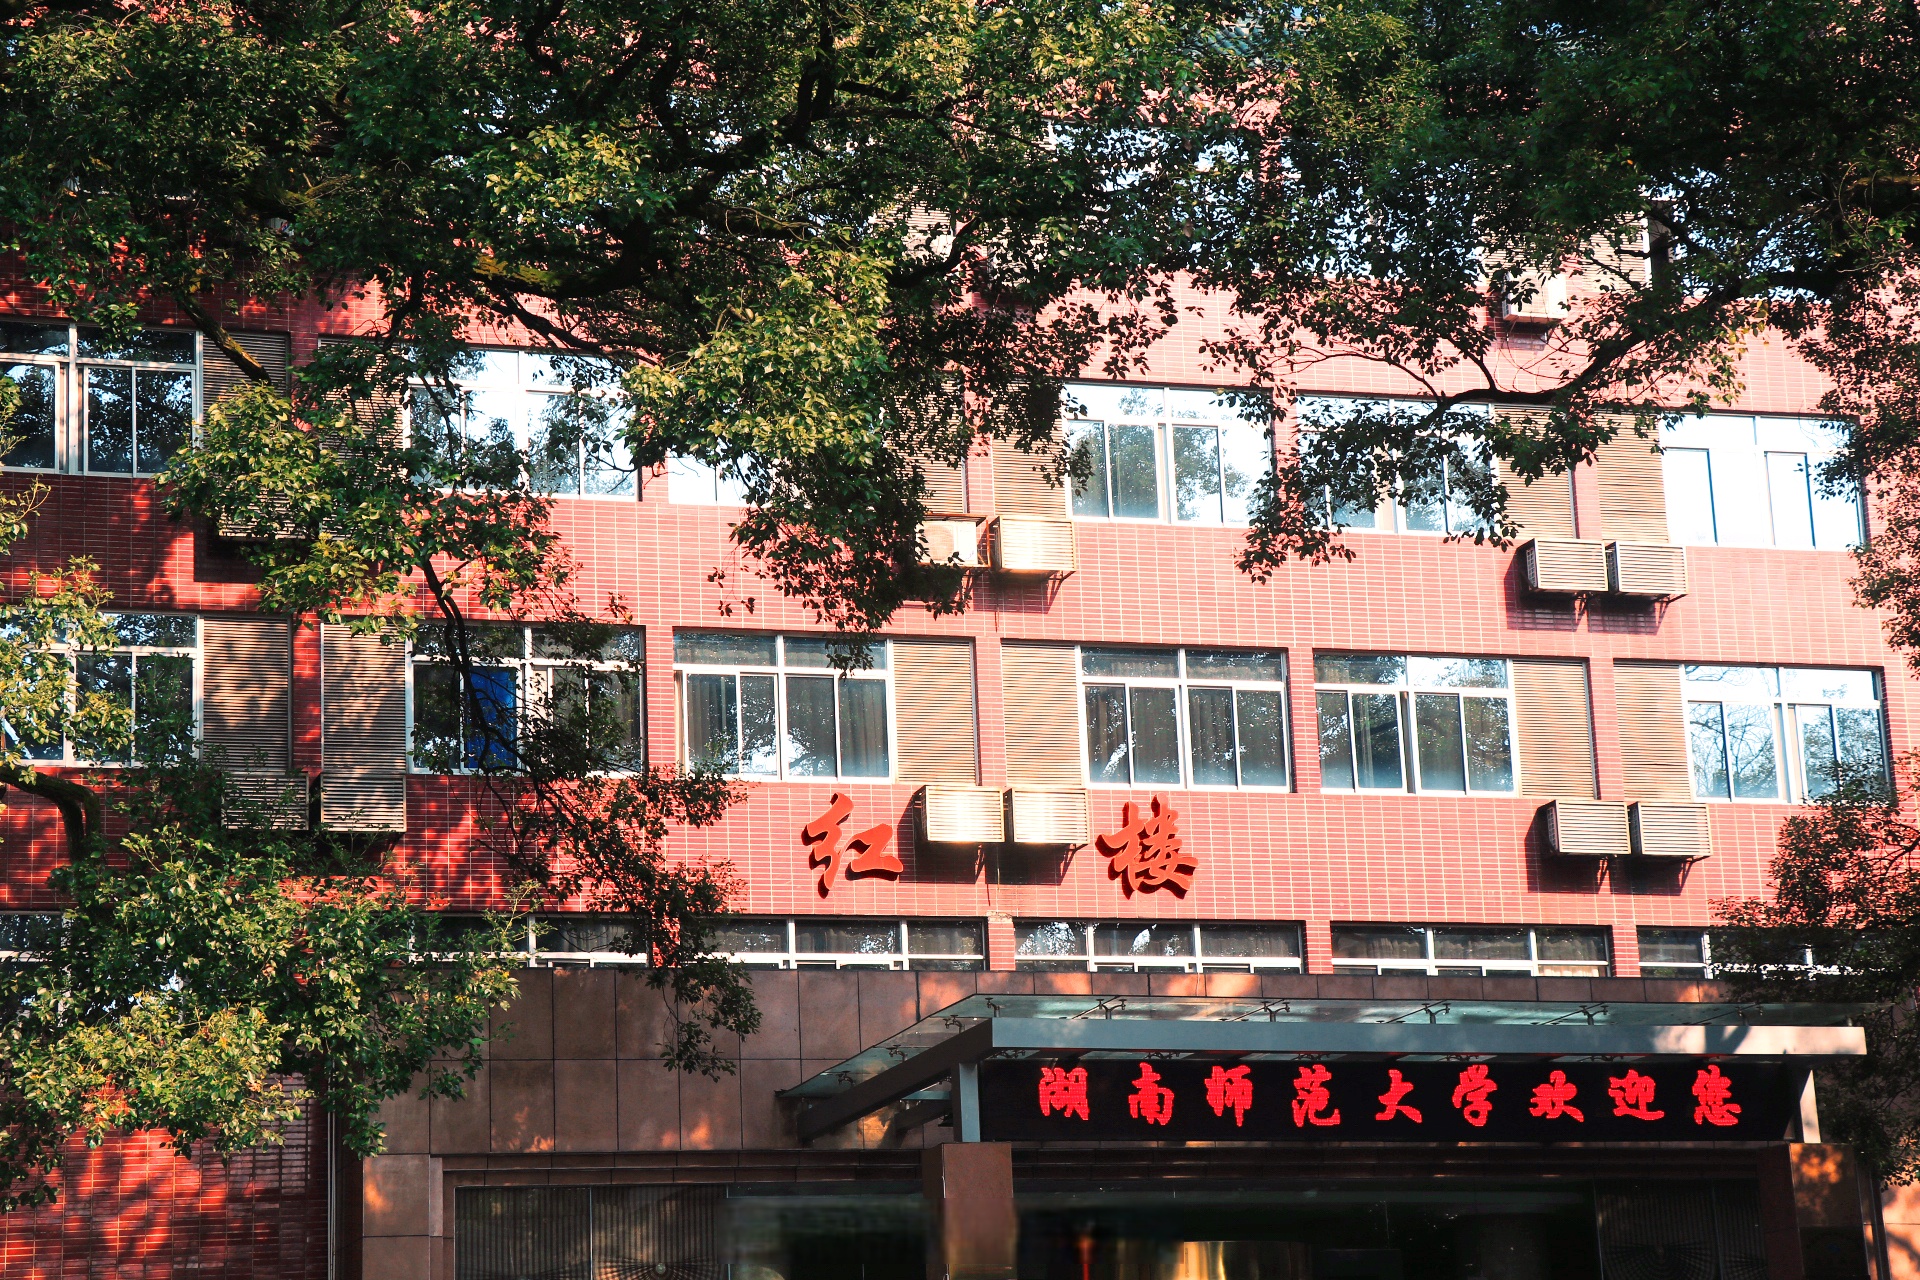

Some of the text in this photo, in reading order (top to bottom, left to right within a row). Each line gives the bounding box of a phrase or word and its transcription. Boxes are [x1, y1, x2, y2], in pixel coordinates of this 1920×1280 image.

[801, 793, 1198, 899] 红楼
[1038, 1062, 1741, 1127] 湖南师范大学欢迎您
